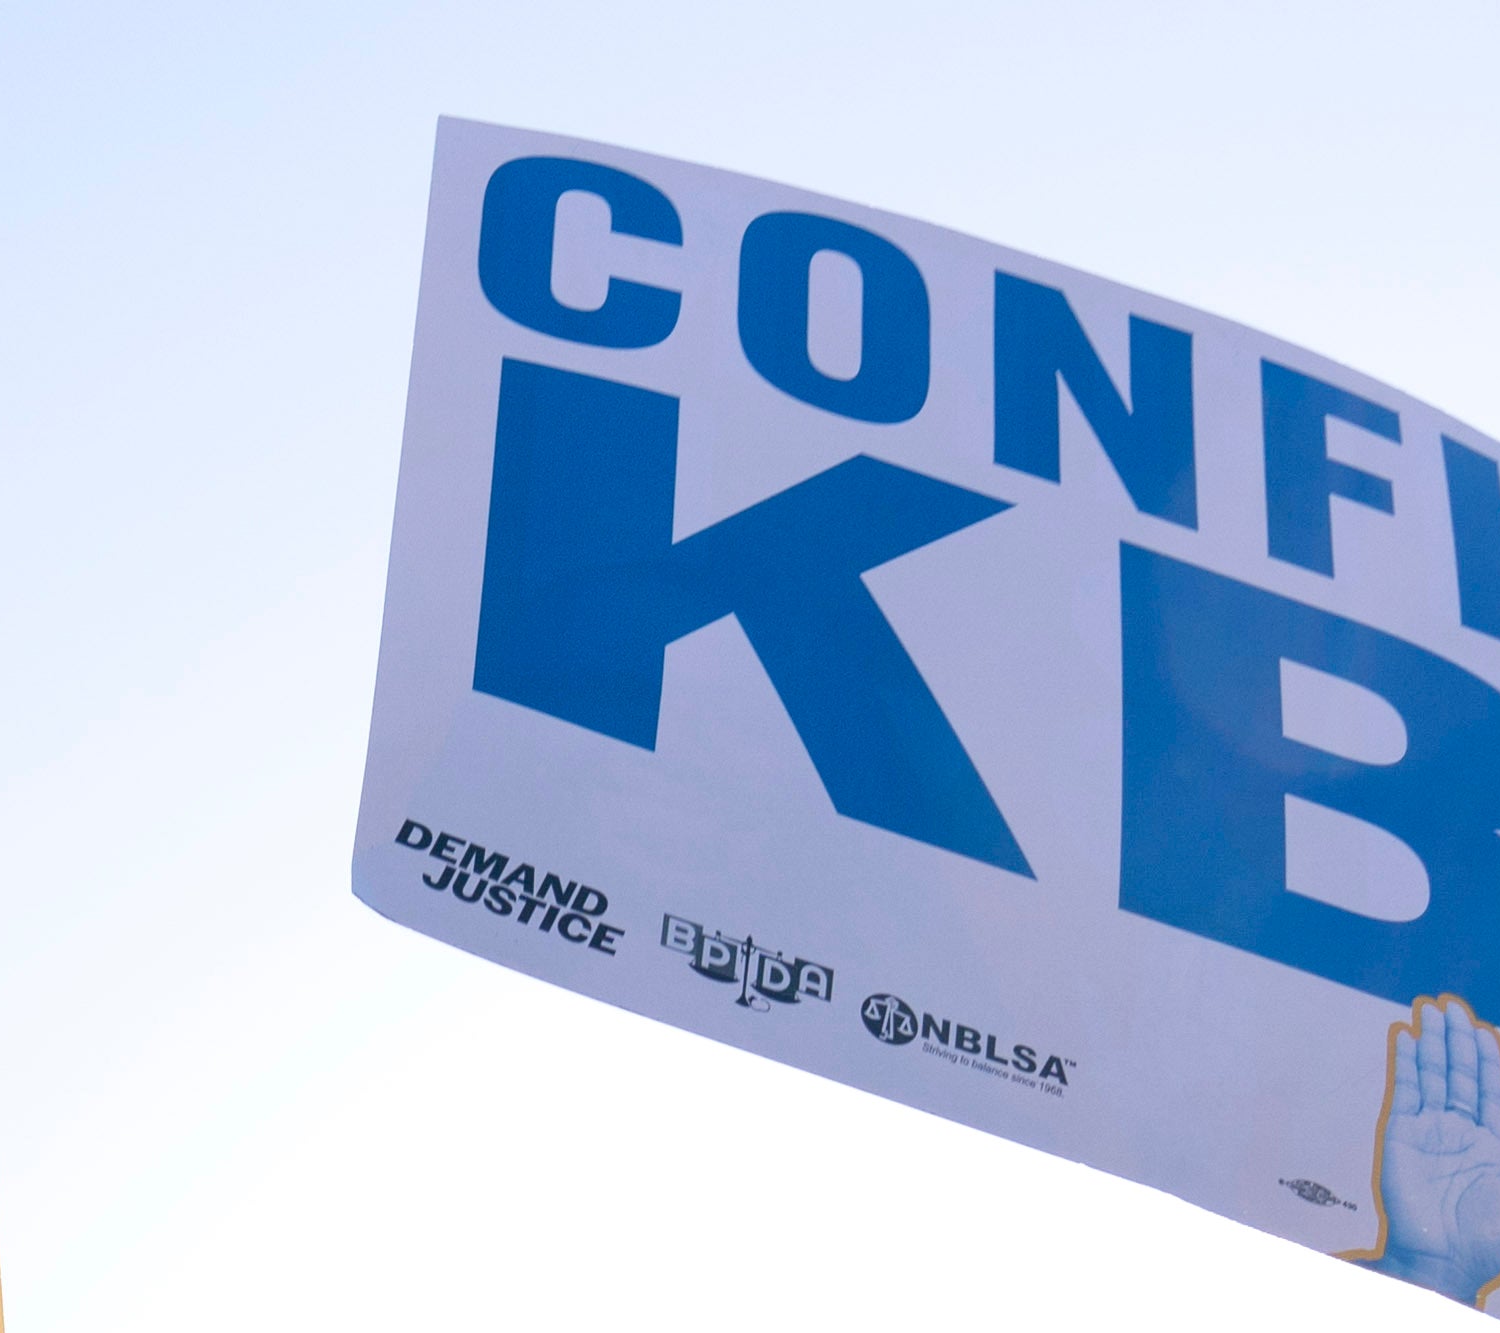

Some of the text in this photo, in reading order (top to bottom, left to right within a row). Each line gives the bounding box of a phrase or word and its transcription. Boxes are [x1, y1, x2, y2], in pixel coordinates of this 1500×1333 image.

[395, 818, 608, 917] DEMAND
[422, 865, 625, 956] JUSTICE
[921, 1042, 958, 1064] Striving
[960, 1055, 969, 1067] to
[972, 1059, 1009, 1080] balance
[1011, 1073, 1036, 1089] since
